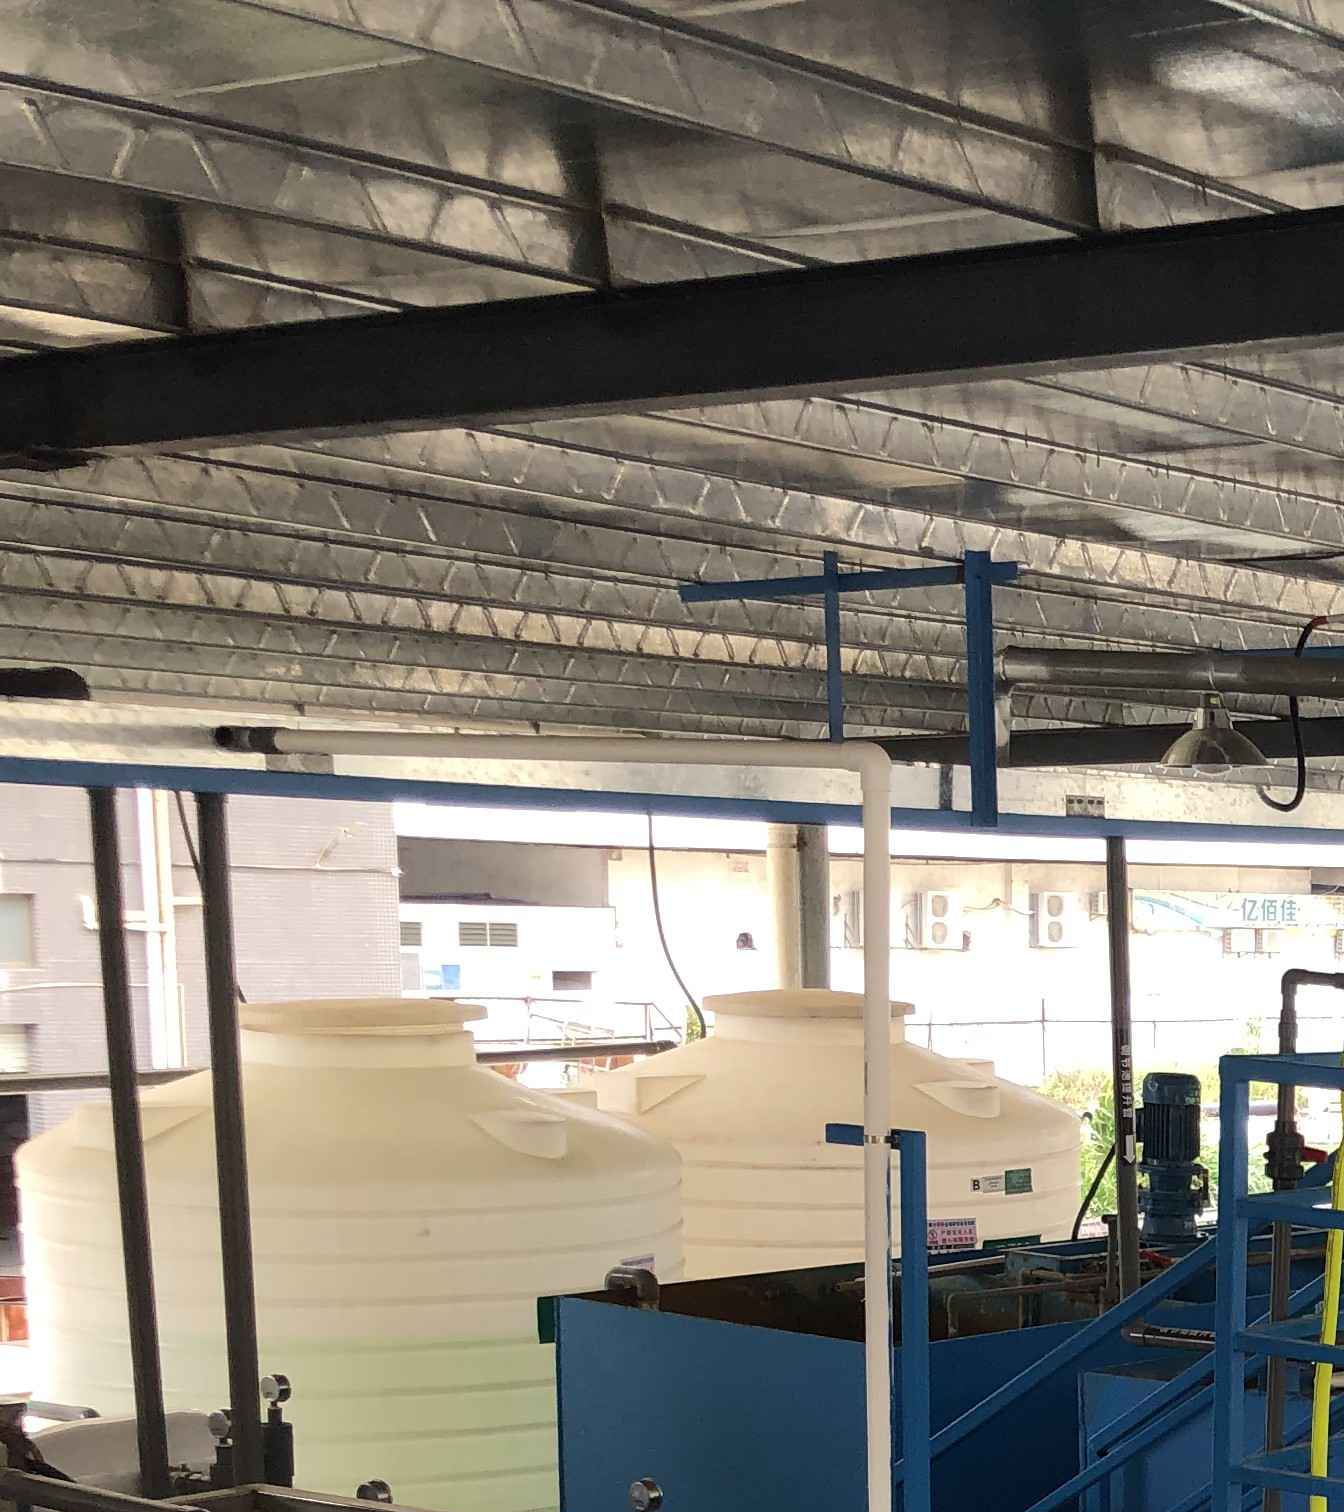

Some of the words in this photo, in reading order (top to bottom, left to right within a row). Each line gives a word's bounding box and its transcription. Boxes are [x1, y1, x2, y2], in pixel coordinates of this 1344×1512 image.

[1241, 898, 1297, 922] 亿佰佳
[972, 1179, 981, 1191] B
